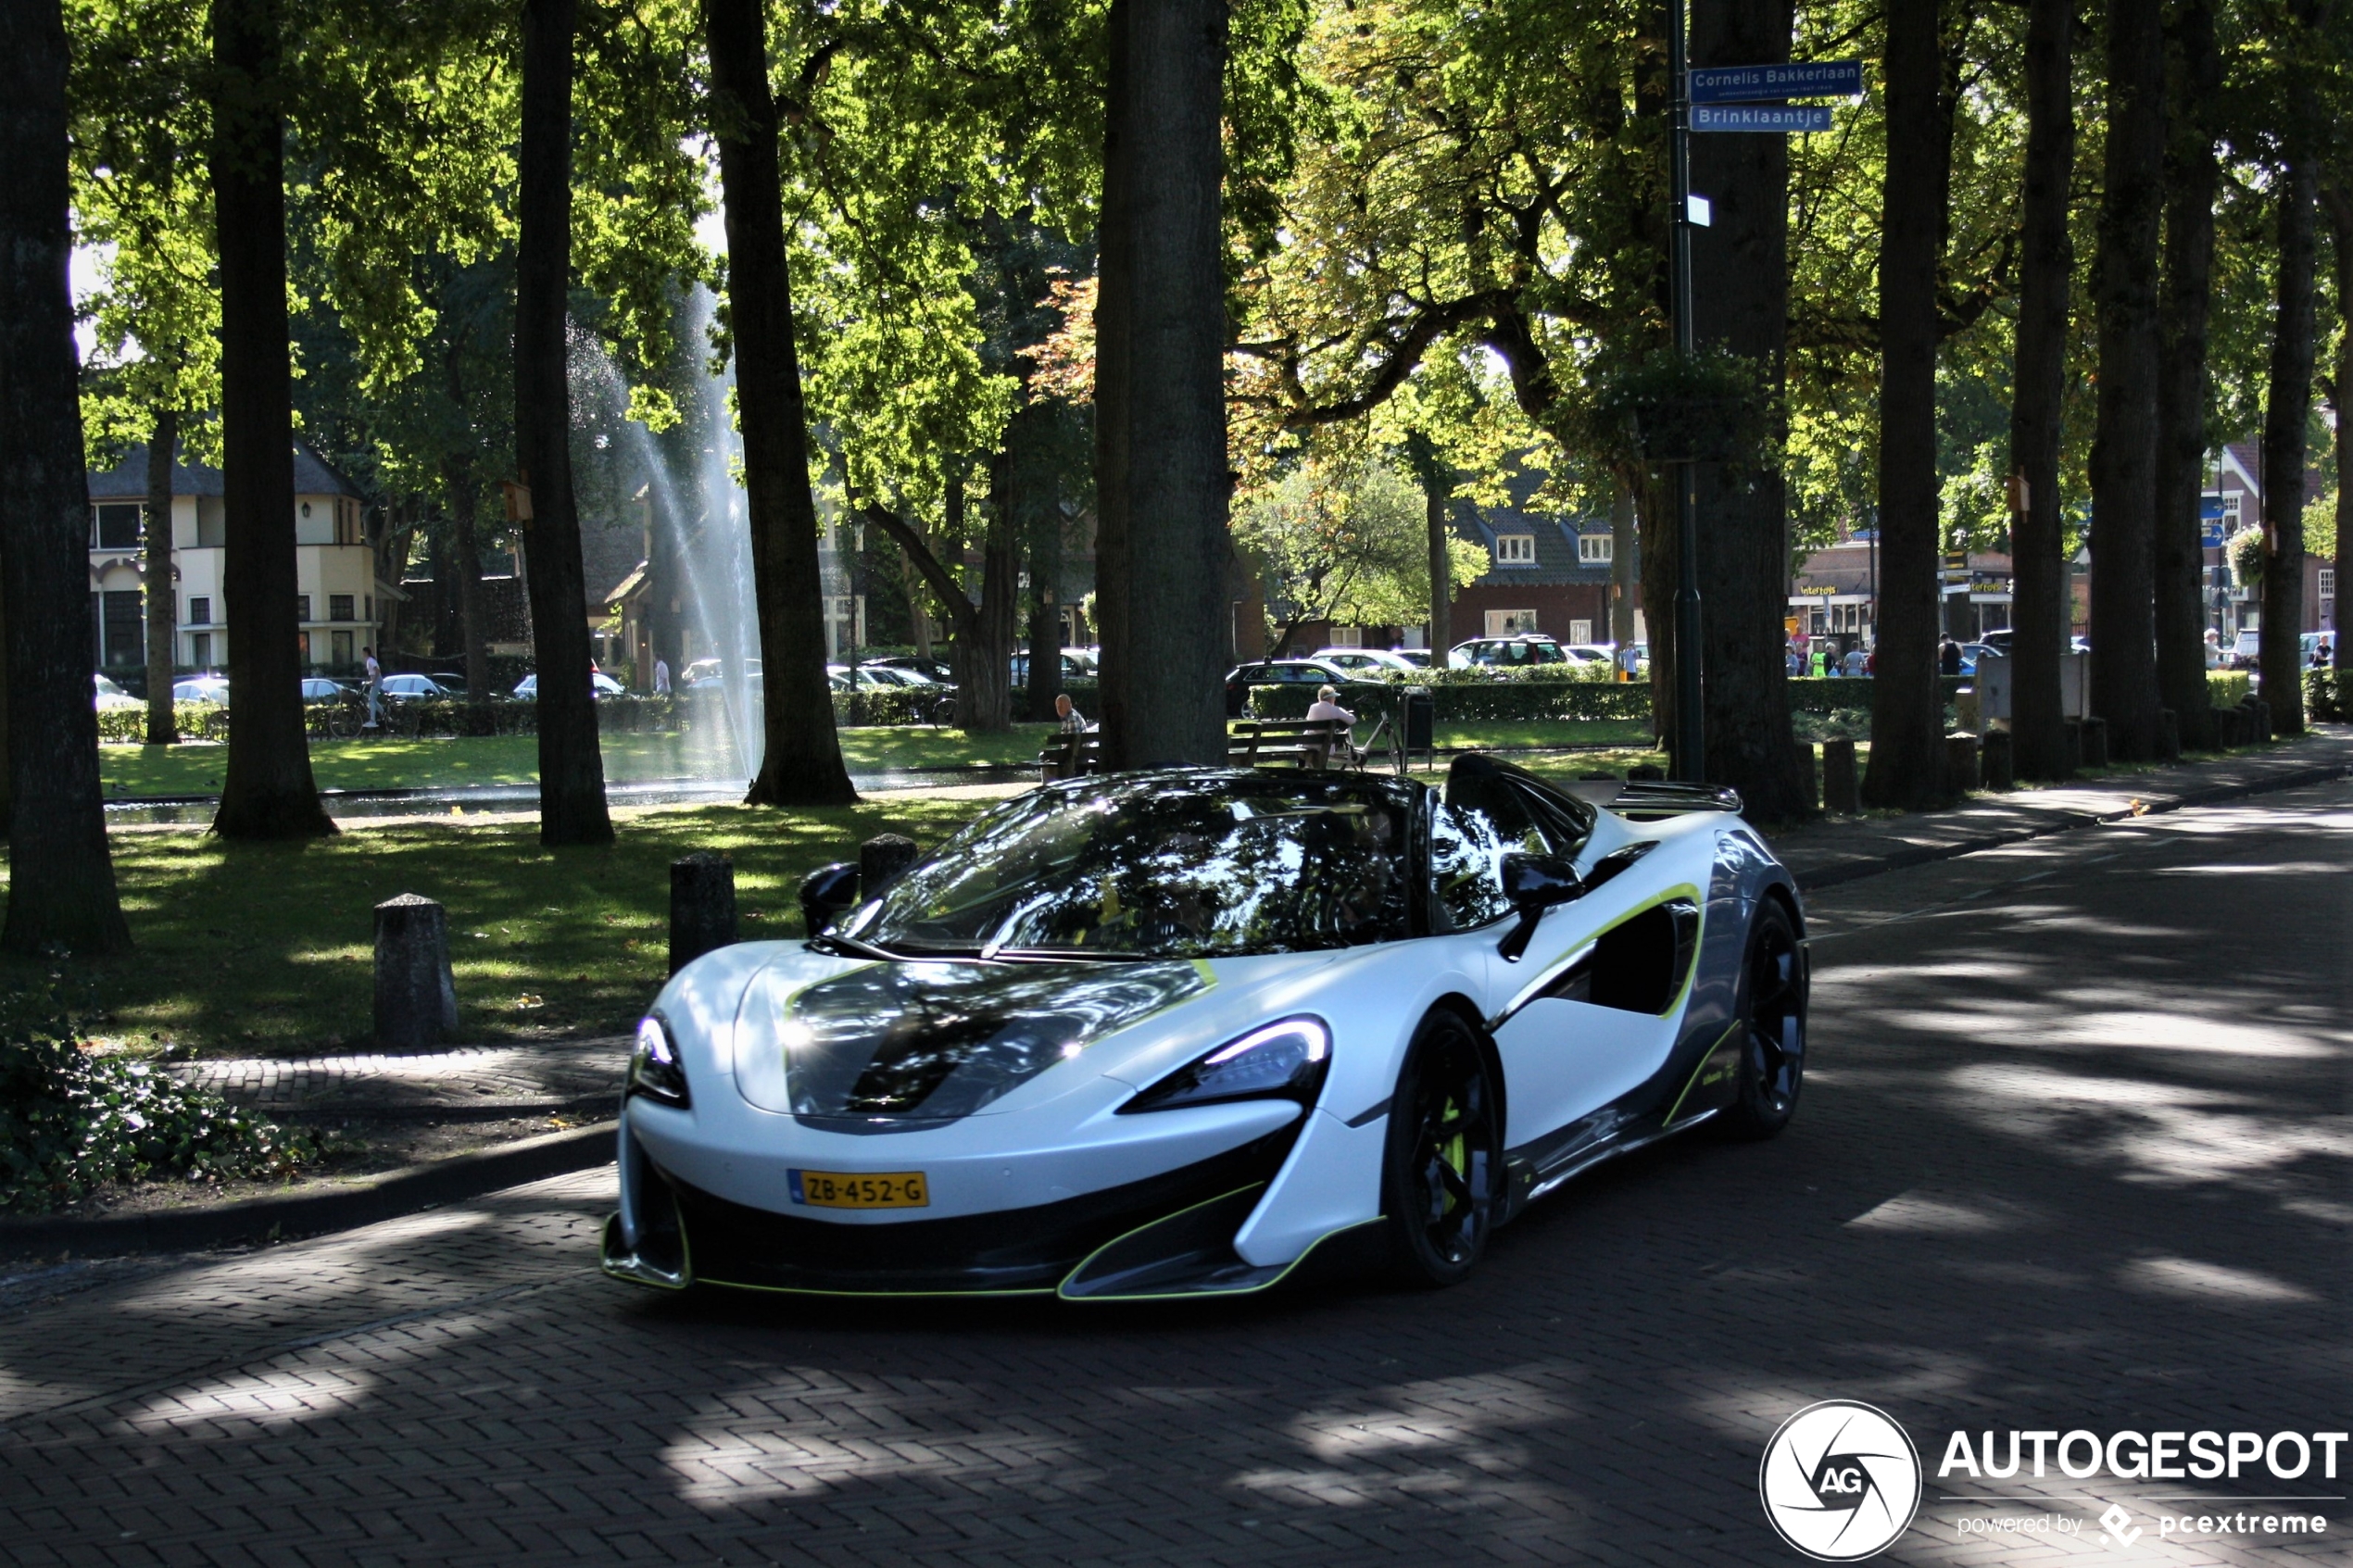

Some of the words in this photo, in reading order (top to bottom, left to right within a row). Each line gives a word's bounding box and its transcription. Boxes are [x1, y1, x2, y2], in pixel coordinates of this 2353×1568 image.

[1695, 72, 1759, 87] Cornelis
[1766, 67, 1856, 83] Bakkerlaan
[1699, 109, 1822, 128] Brinklaantje
[808, 1178, 921, 1202] ZB-452-G
